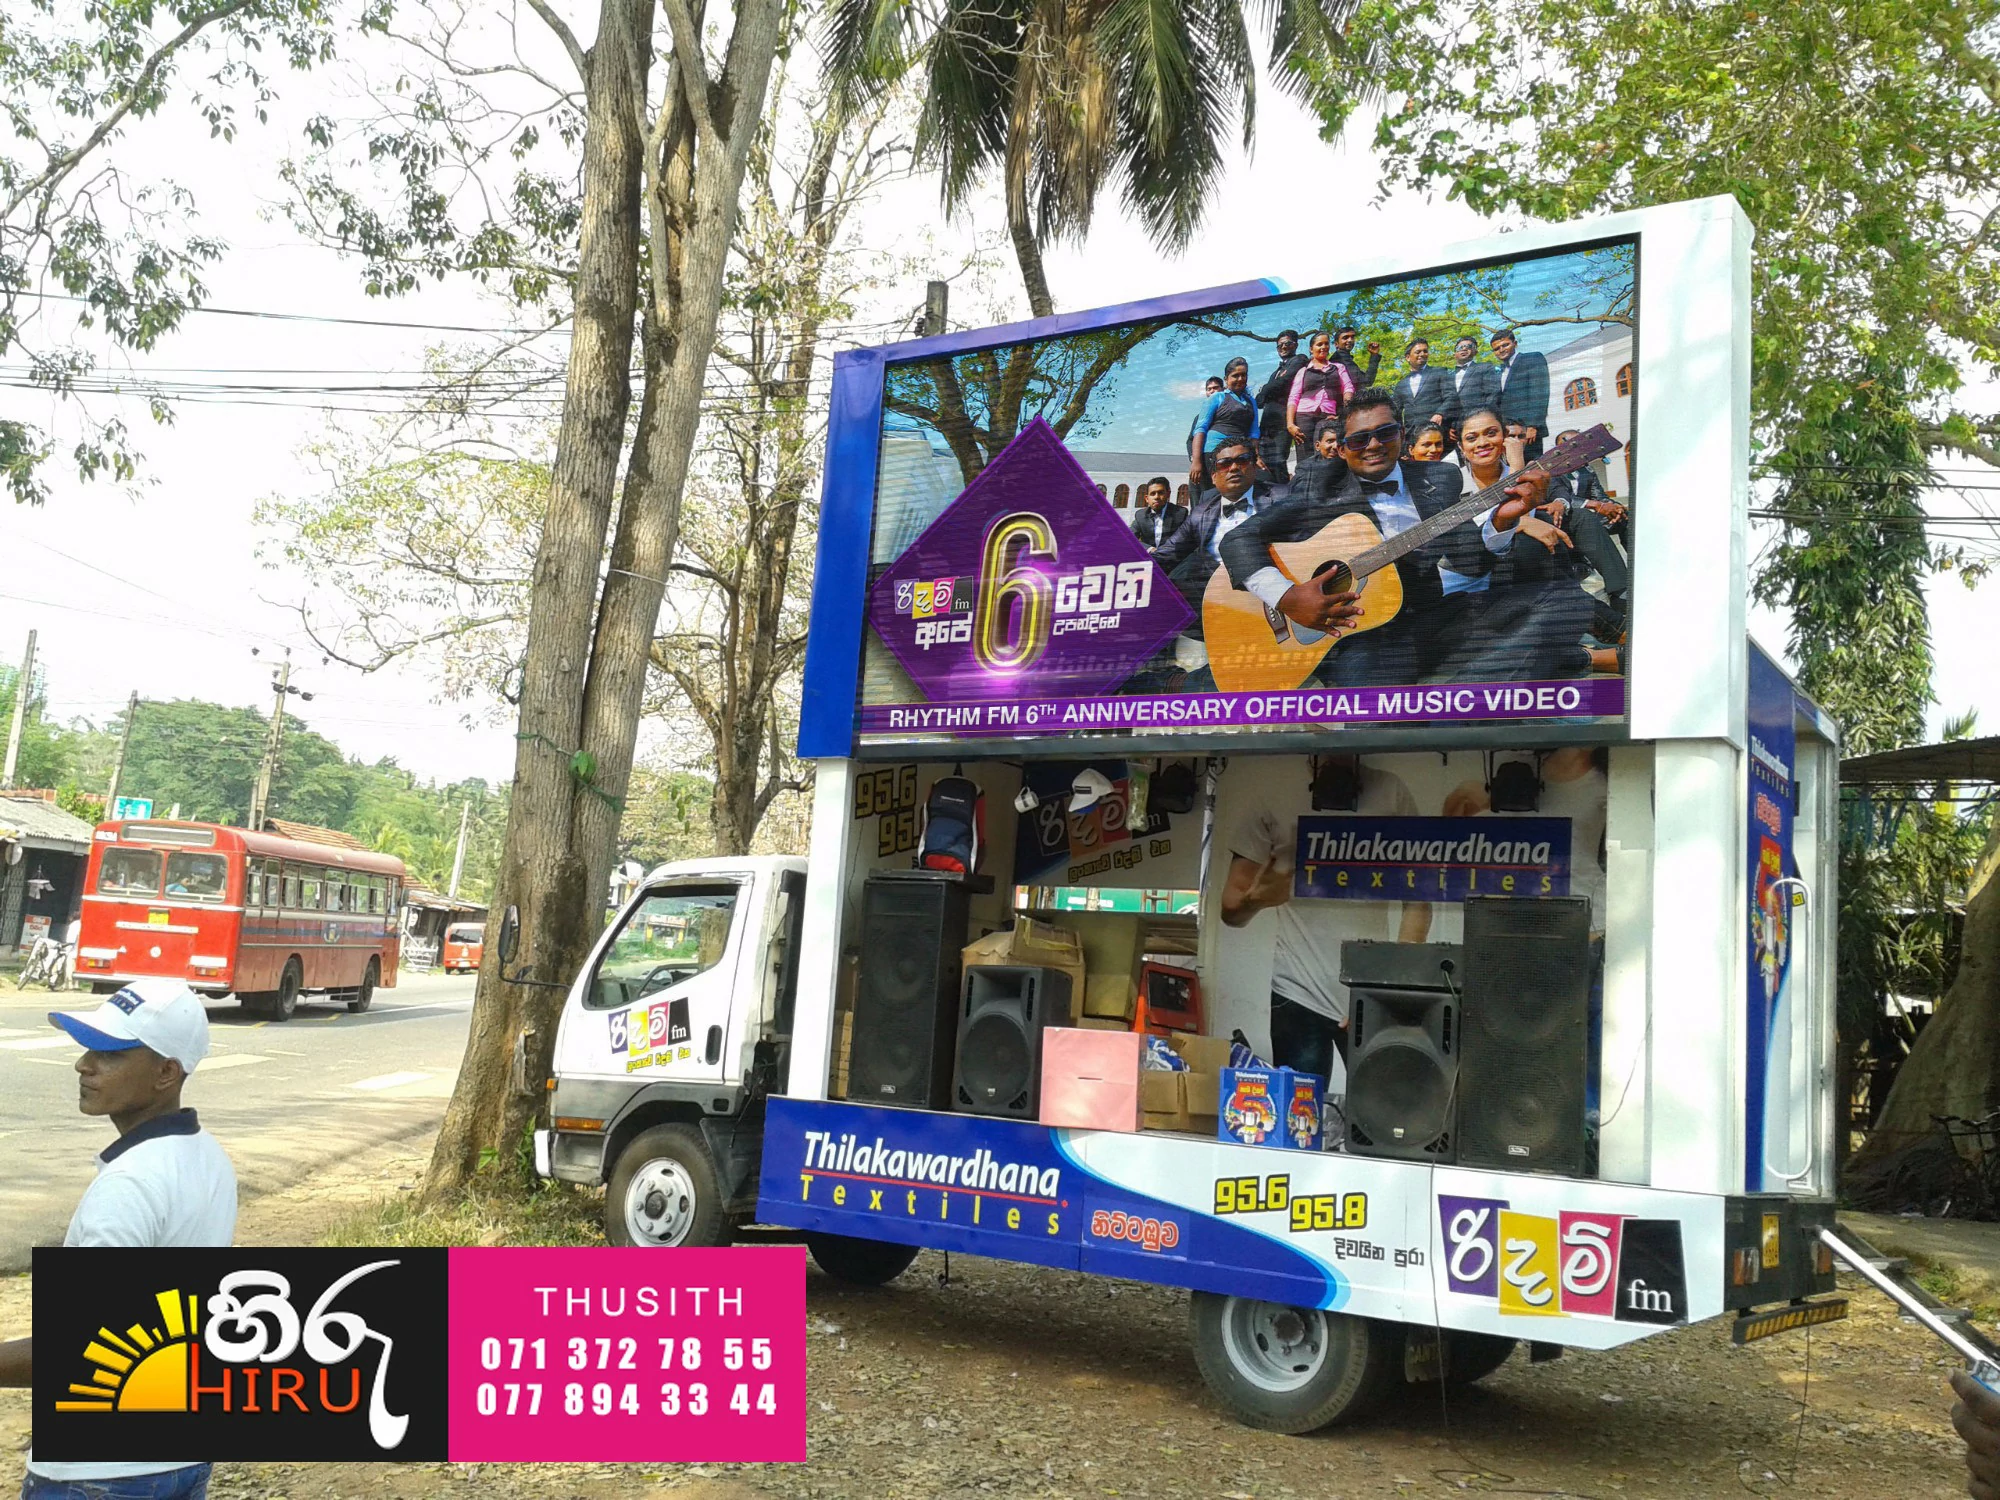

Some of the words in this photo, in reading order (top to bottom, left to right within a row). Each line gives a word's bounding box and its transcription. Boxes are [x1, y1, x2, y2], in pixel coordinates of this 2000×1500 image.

[915, 612, 974, 650] අපේ
[974, 511, 1058, 675] 6
[1054, 561, 1154, 614] වෙනි
[955, 597, 970, 609] fm
[1053, 612, 1120, 635] උපන්දිනේ
[889, 706, 981, 728] RHYTHM
[987, 705, 1020, 726] FM
[1026, 703, 1057, 725] 6TH
[1062, 698, 1238, 723] ANNIVERSARY
[1245, 694, 1369, 719] OFFICIAL
[1377, 690, 1475, 715] MUSIC
[1483, 686, 1581, 711] VIDEO
[855, 765, 917, 819] 95.6
[879, 806, 928, 858] 95.
[1307, 831, 1551, 864] Thilakawardhana
[1304, 865, 1552, 893] Textiles
[671, 1025, 687, 1040] fm
[804, 1131, 1060, 1197] Thilakawardhana
[800, 1174, 1059, 1235] Textiles
[1214, 1173, 1290, 1215] 95.6
[1289, 1192, 1368, 1232] 95.8
[1333, 1237, 1385, 1260] දිවයින
[1394, 1247, 1424, 1268] පුරා
[1627, 1278, 1674, 1313] fm
